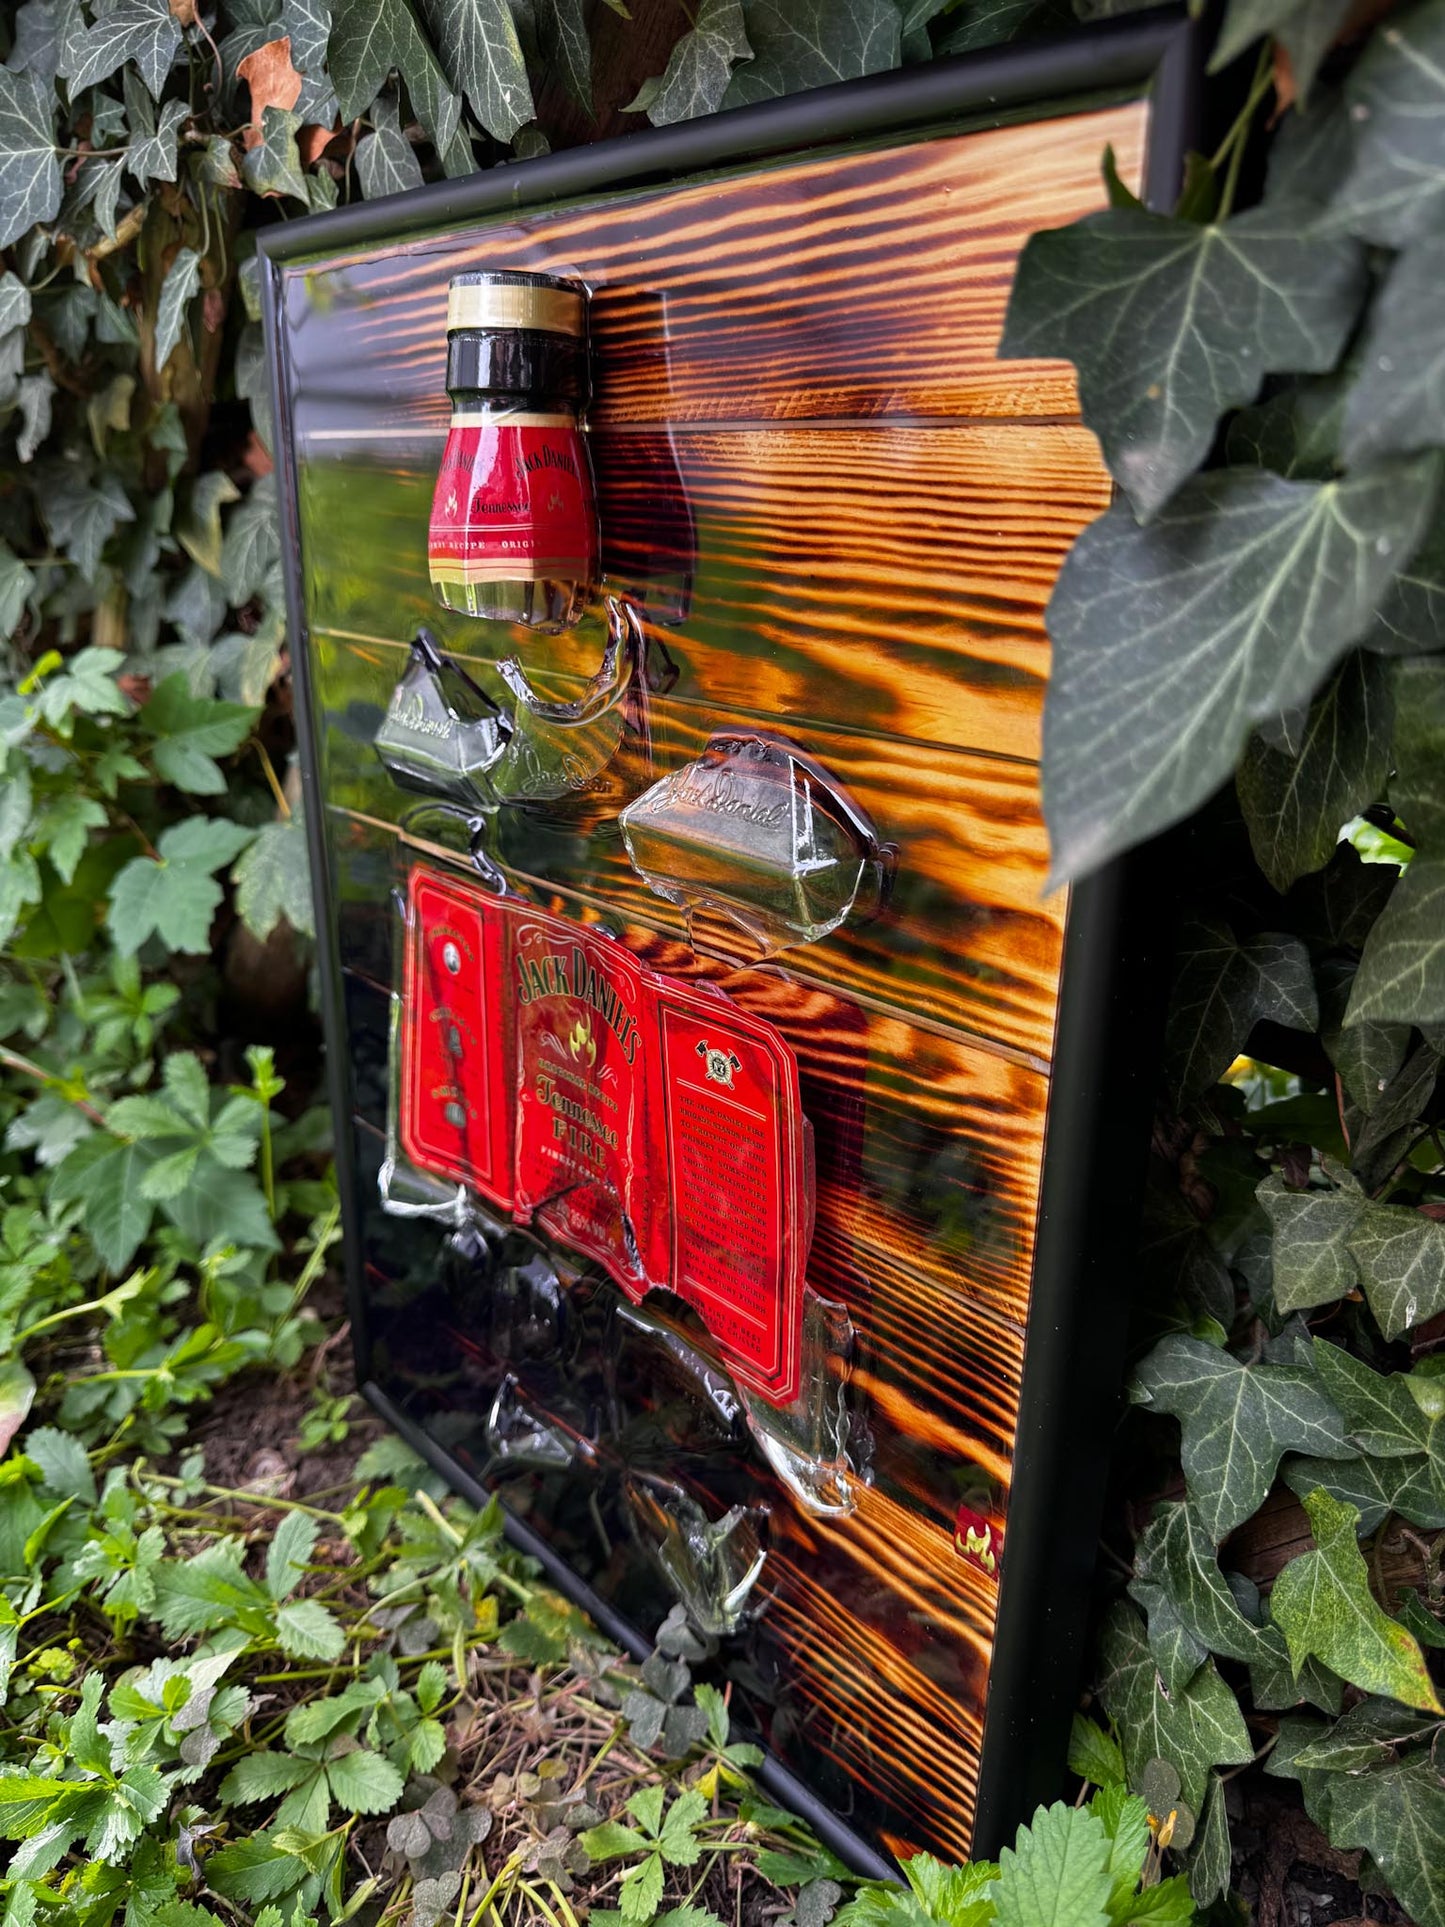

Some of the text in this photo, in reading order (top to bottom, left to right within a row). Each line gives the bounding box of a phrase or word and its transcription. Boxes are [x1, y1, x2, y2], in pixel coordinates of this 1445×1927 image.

[516, 952, 571, 1006] JACK
[572, 945, 642, 1066] DANIEL'S
[535, 1073, 619, 1152] Tennessee
[551, 1116, 608, 1171] FIRE
